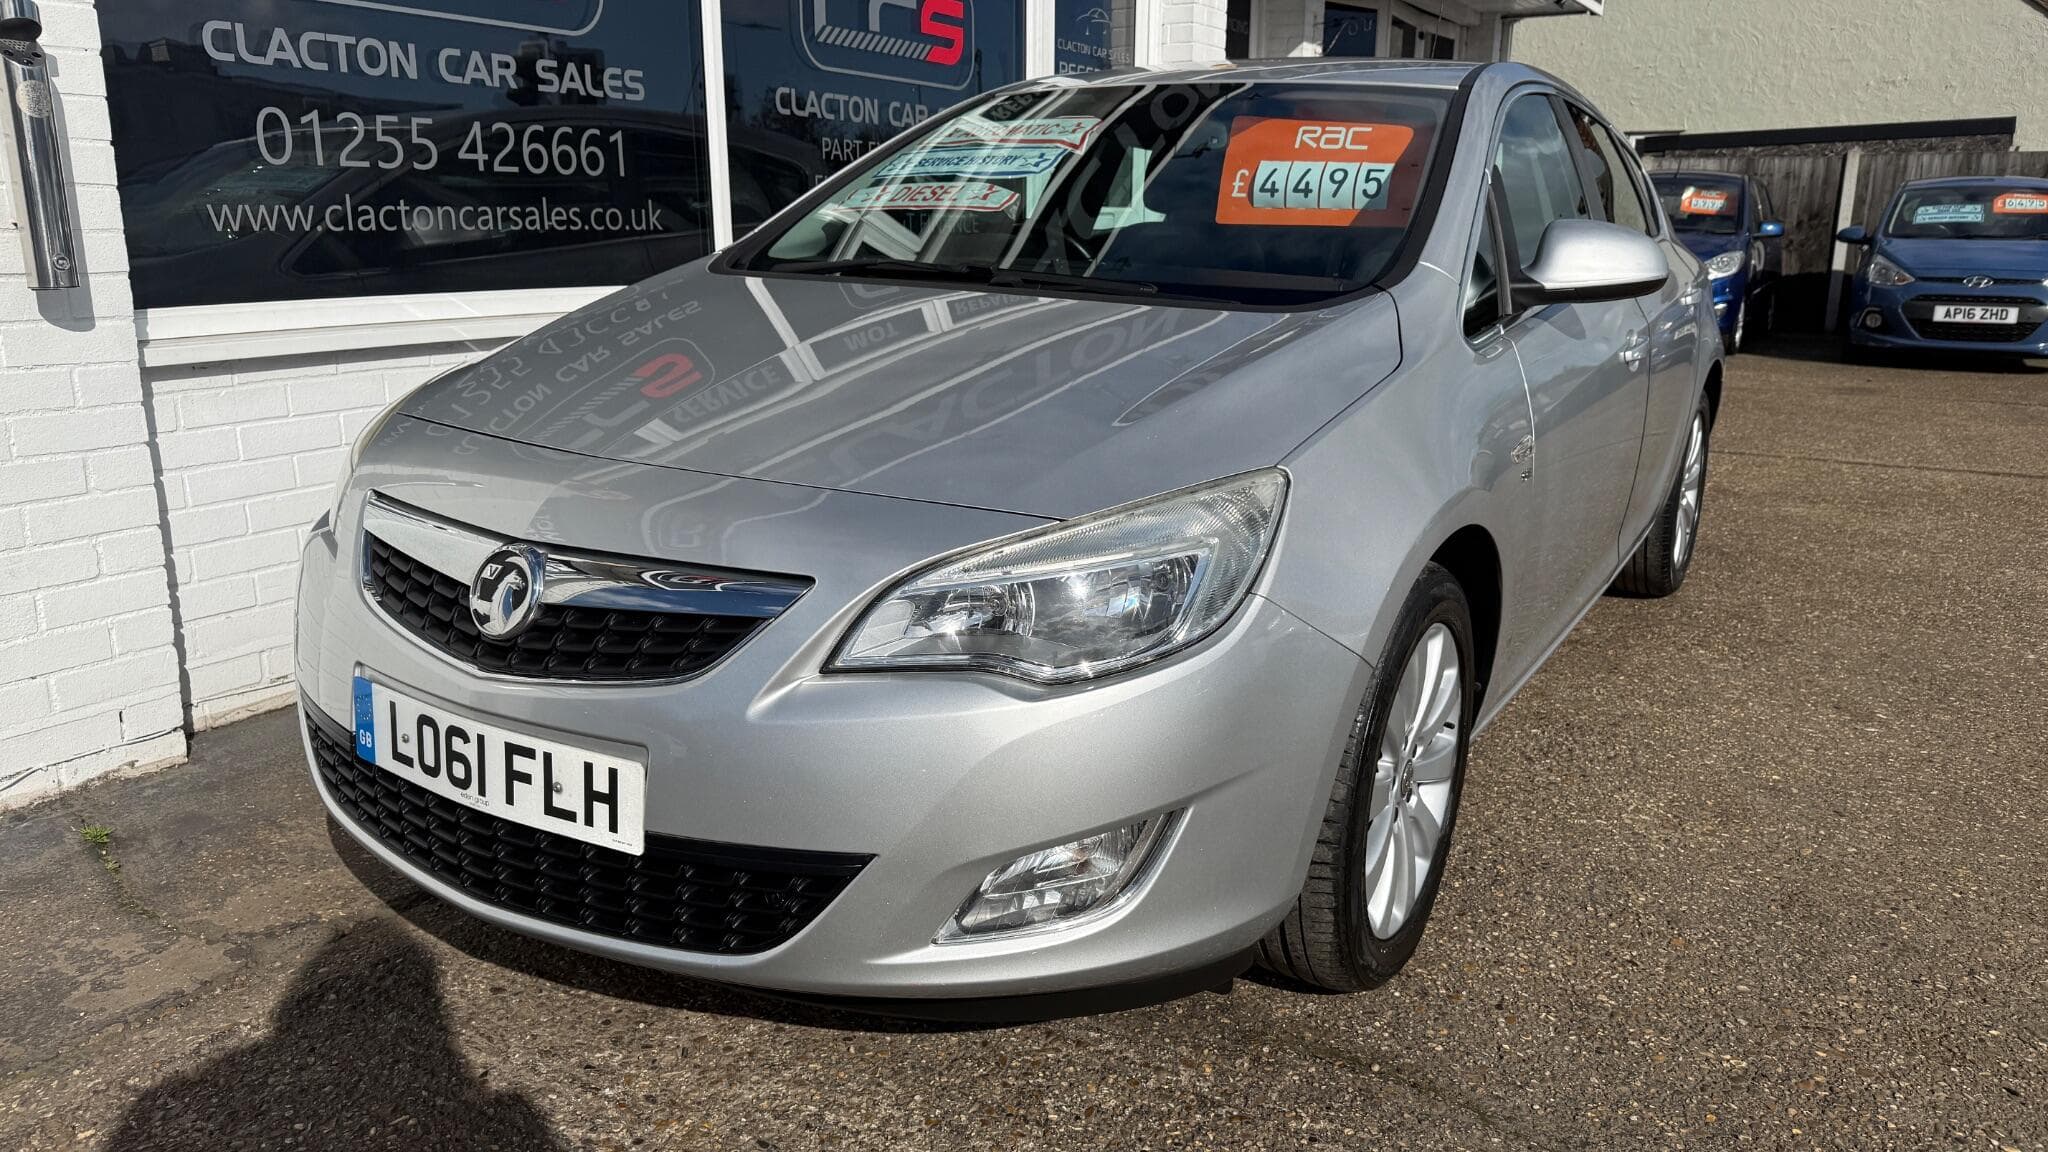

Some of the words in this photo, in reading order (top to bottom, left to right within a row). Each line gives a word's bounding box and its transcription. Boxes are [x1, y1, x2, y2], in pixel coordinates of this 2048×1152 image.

[201, 20, 418, 80] CLACTON
[438, 47, 519, 90] CAR
[537, 59, 646, 102] SALES
[1057, 38, 1091, 56] CLACTON
[1093, 45, 1108, 59] CAR
[775, 86, 879, 126] CLACTON
[255, 105, 439, 171] 01255
[458, 119, 627, 179] 426661
[822, 137, 864, 162] PART
[914, 156, 966, 169] SERVICE
[966, 153, 1022, 166] HISTORY
[888, 184, 964, 203] DIESEL
[207, 194, 665, 234] www.clactoncarsales.co.uk
[1943, 307, 1976, 321] AP16
[1980, 307, 2009, 321] ZHD
[359, 729, 373, 749] GB
[389, 700, 487, 798] LO61
[504, 740, 619, 834] FLH
